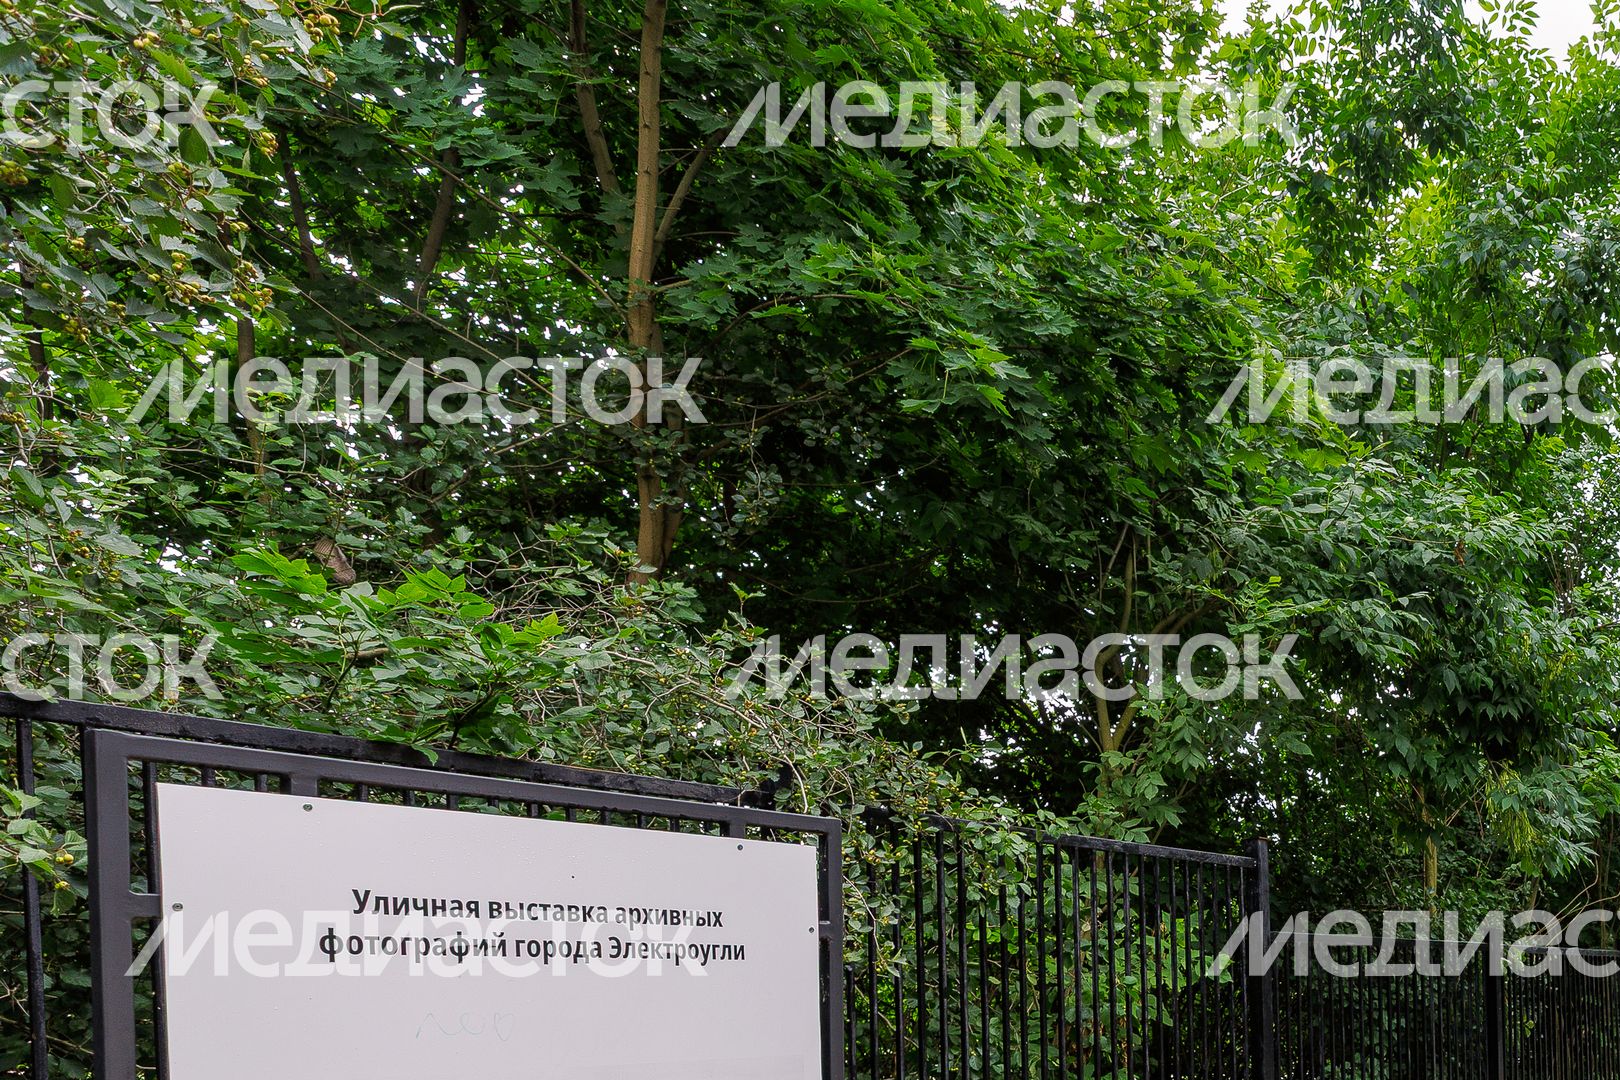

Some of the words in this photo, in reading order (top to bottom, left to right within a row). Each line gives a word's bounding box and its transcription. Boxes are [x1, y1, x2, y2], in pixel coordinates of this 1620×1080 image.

[351, 889, 480, 918] Уличная
[488, 901, 608, 924] выставка
[614, 905, 724, 931] архивных
[319, 927, 507, 963] фотографий
[514, 938, 602, 965] города
[607, 936, 746, 967] Электроугли
